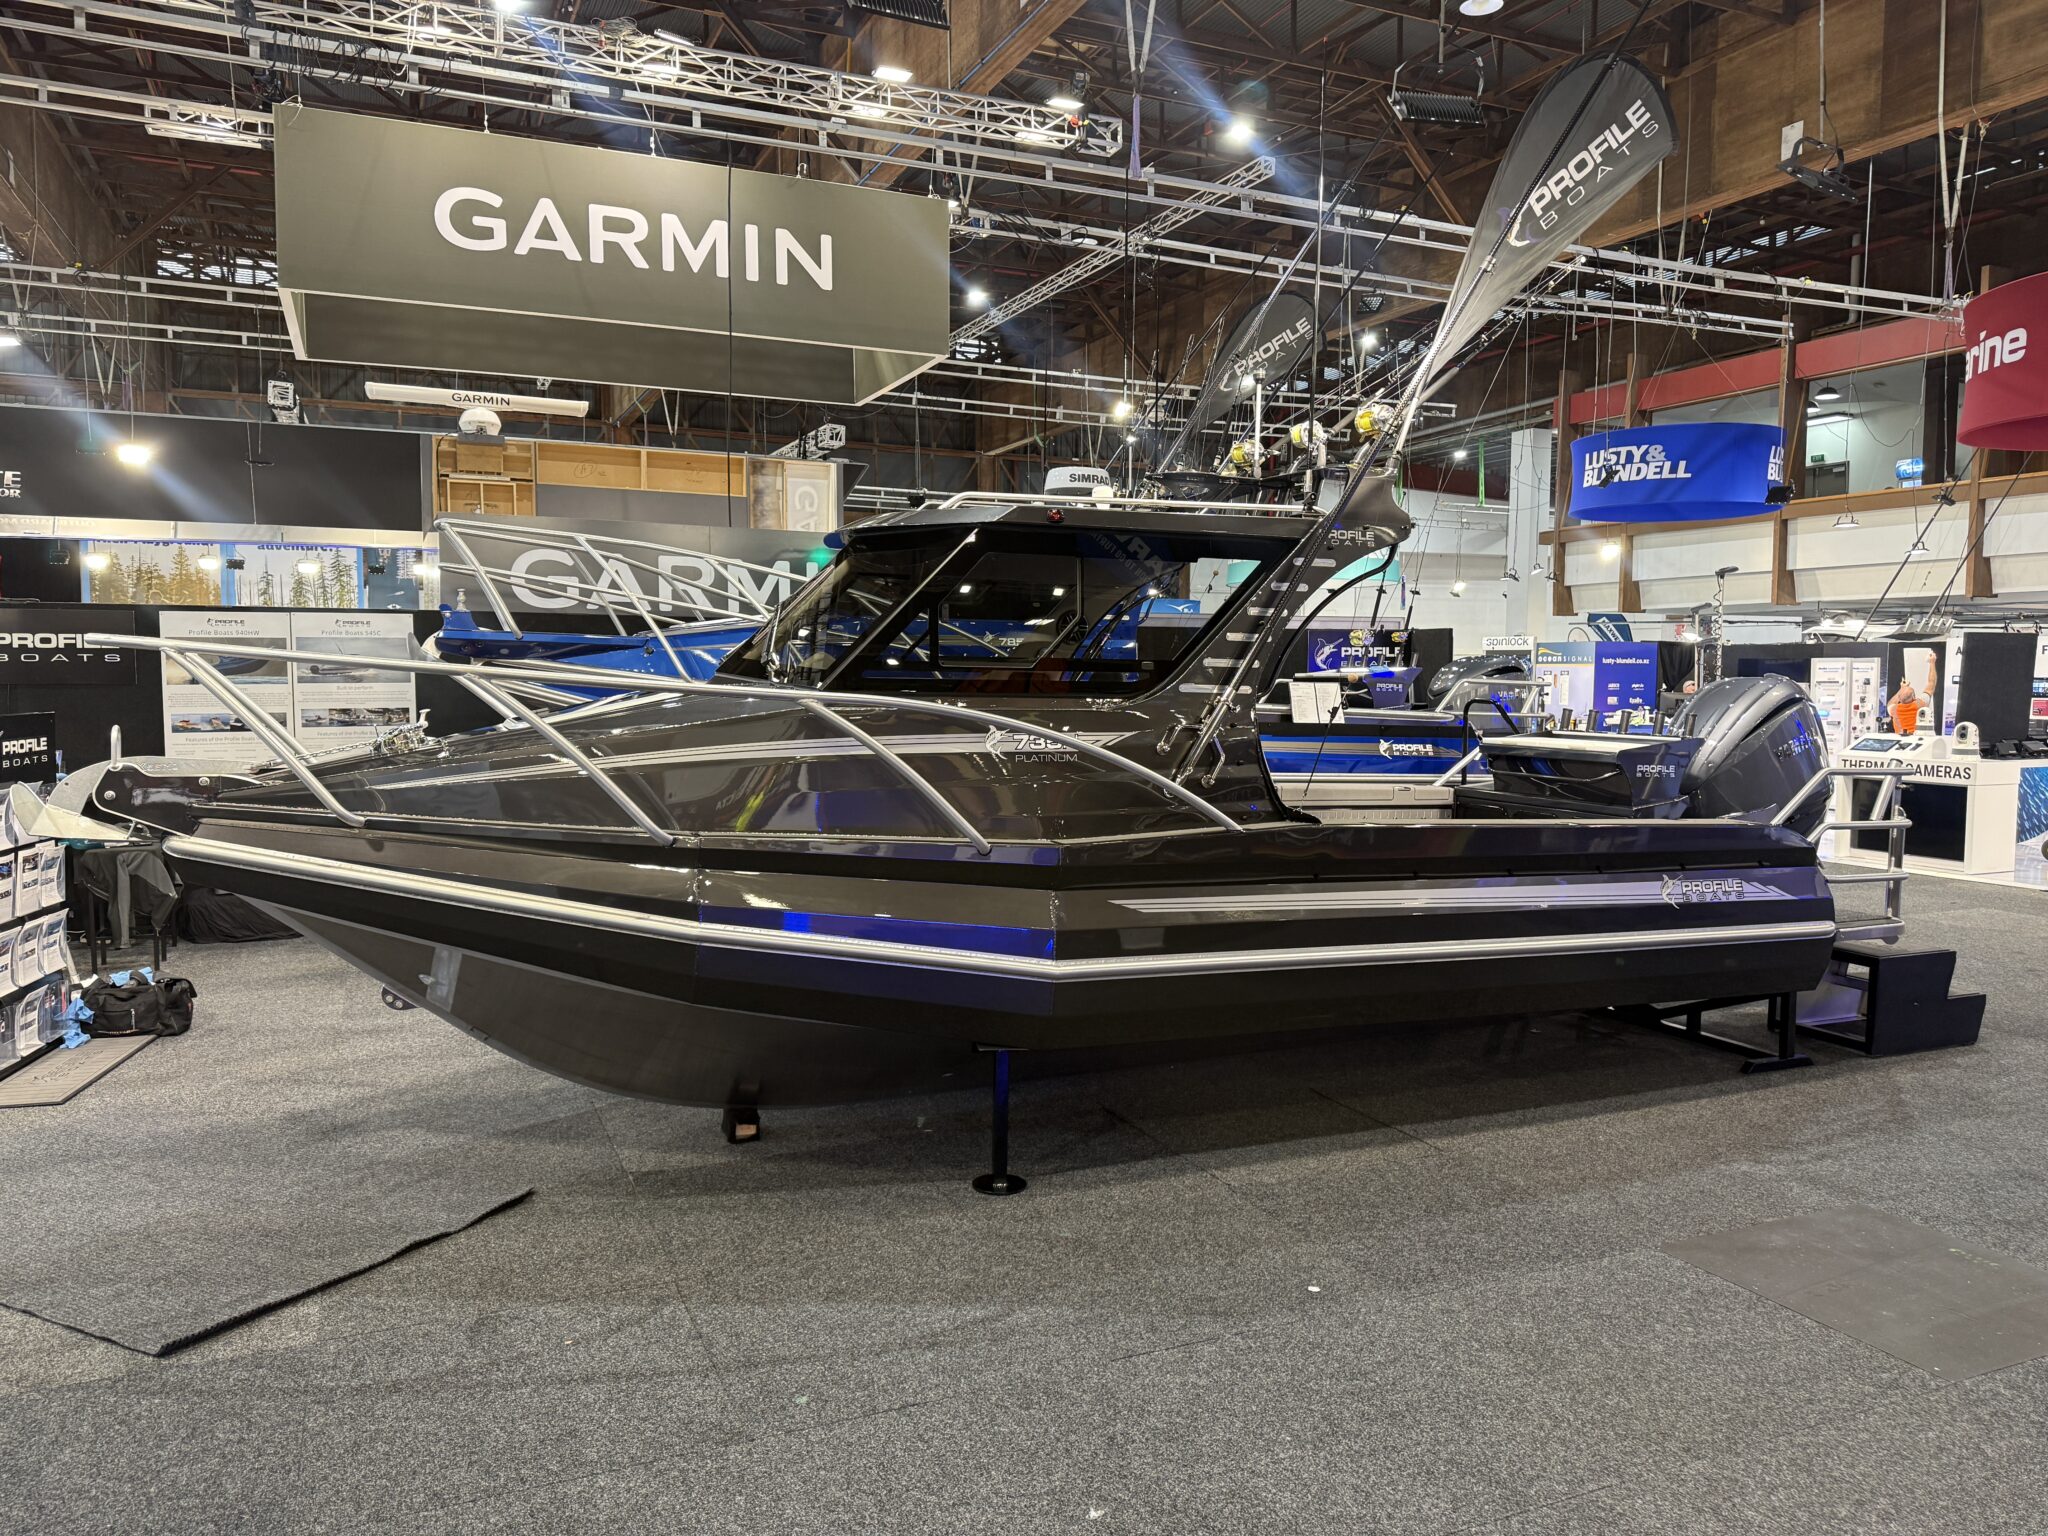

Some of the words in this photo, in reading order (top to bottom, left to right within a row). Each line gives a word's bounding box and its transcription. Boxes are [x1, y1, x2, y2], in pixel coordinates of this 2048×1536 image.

[1529, 99, 1651, 217] PROFILE
[1539, 120, 1659, 230] BOATS
[433, 186, 833, 291] GARMIN
[1233, 316, 1311, 377] PROFILE
[451, 392, 511, 407] GARMIN
[1069, 473, 1110, 486] SIMRAD
[1583, 460, 1692, 488] BLNDELL
[1328, 529, 1375, 541] ROFILE
[1331, 539, 1375, 547] OATS
[1486, 637, 1530, 650] spinlock
[2, 737, 48, 755] PROFILE
[1392, 743, 1434, 752] PROFILE
[2, 754, 48, 768] BOATS
[1015, 753, 1079, 763] PLATINUM
[1636, 765, 1676, 773] PROFILE
[1682, 880, 1744, 894] PROFILE
[1683, 892, 1745, 902] BOATS
